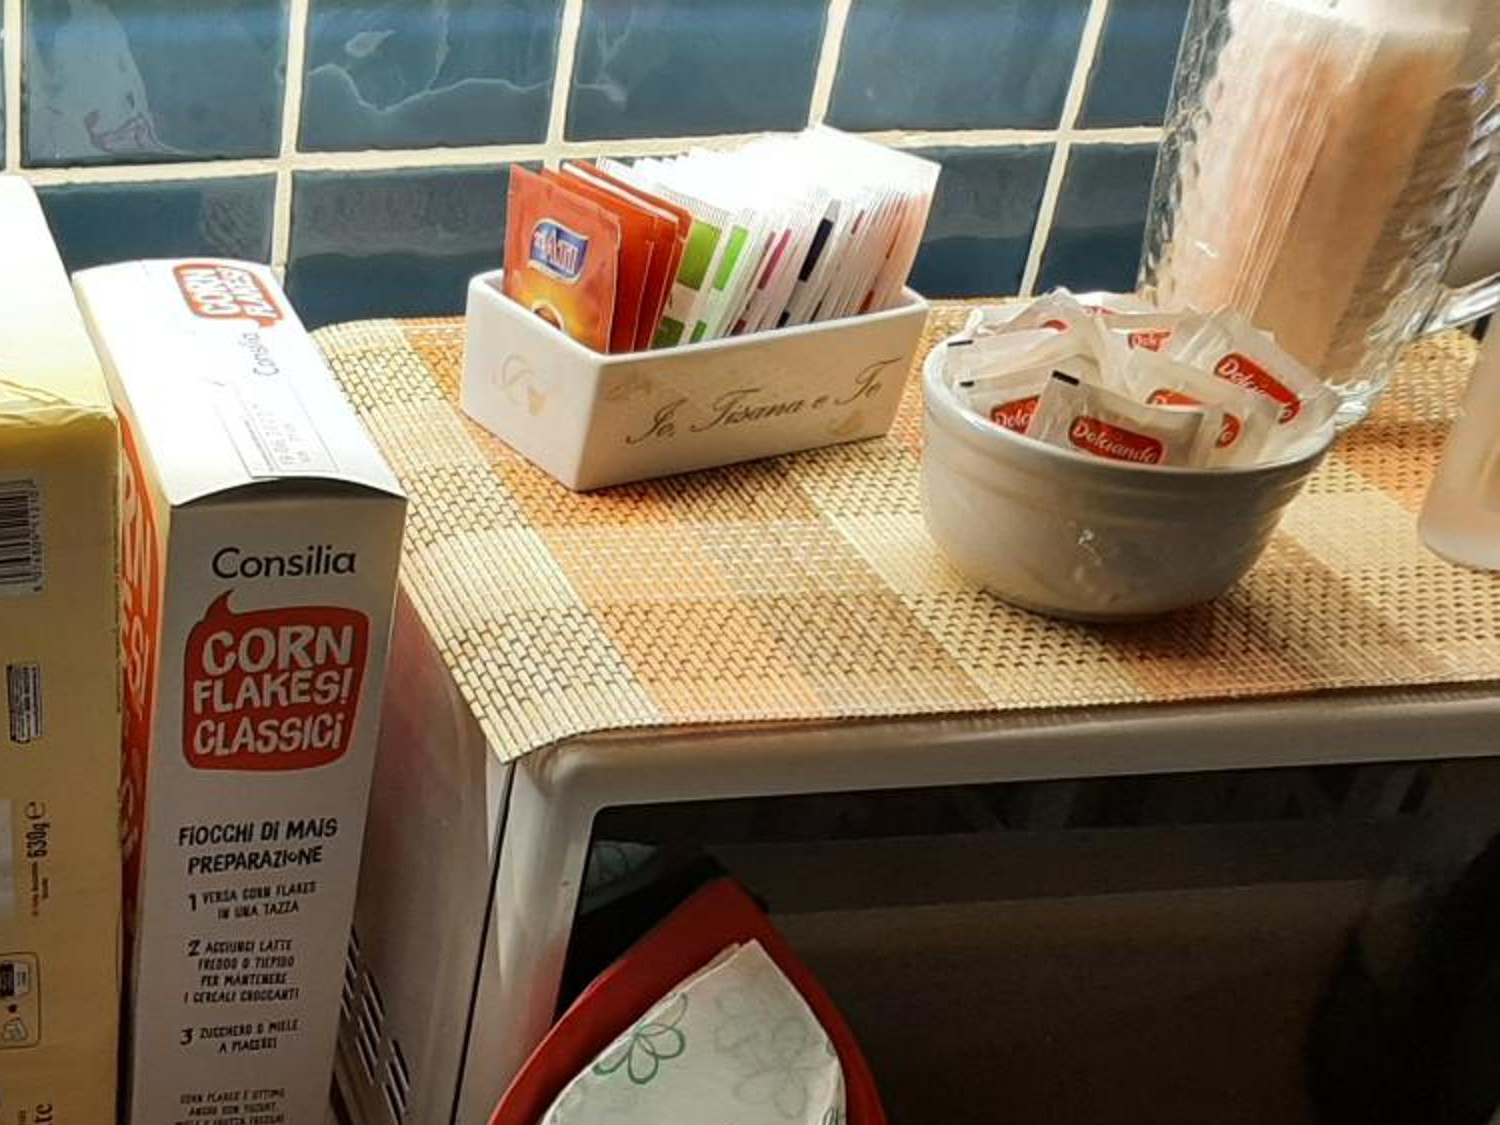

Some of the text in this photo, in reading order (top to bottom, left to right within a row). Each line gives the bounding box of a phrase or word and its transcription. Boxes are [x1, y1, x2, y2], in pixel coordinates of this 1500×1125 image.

[690, 387, 804, 432] Tisana
[211, 544, 357, 579] Consilia
[202, 624, 354, 677] CORN
[192, 667, 353, 714] FLAKES!
[285, 817, 338, 840] MAIS
[187, 845, 323, 875] PREPARAZIONE
[187, 881, 316, 912] 1 VERSA CORN FLAKES
[217, 900, 298, 919] IN UNA TAZZA
[187, 938, 292, 956] 2 AGGIUNGI LATTE
[197, 957, 237, 970] FREDDO
[255, 955, 294, 969] TIEPIDO
[200, 972, 286, 986] PER MANTENERE
[193, 990, 236, 1003] CEREALI
[179, 1027, 193, 1045] 3
[198, 1023, 252, 1038] ZUCCHERO
[268, 1019, 298, 1032] MIELE
